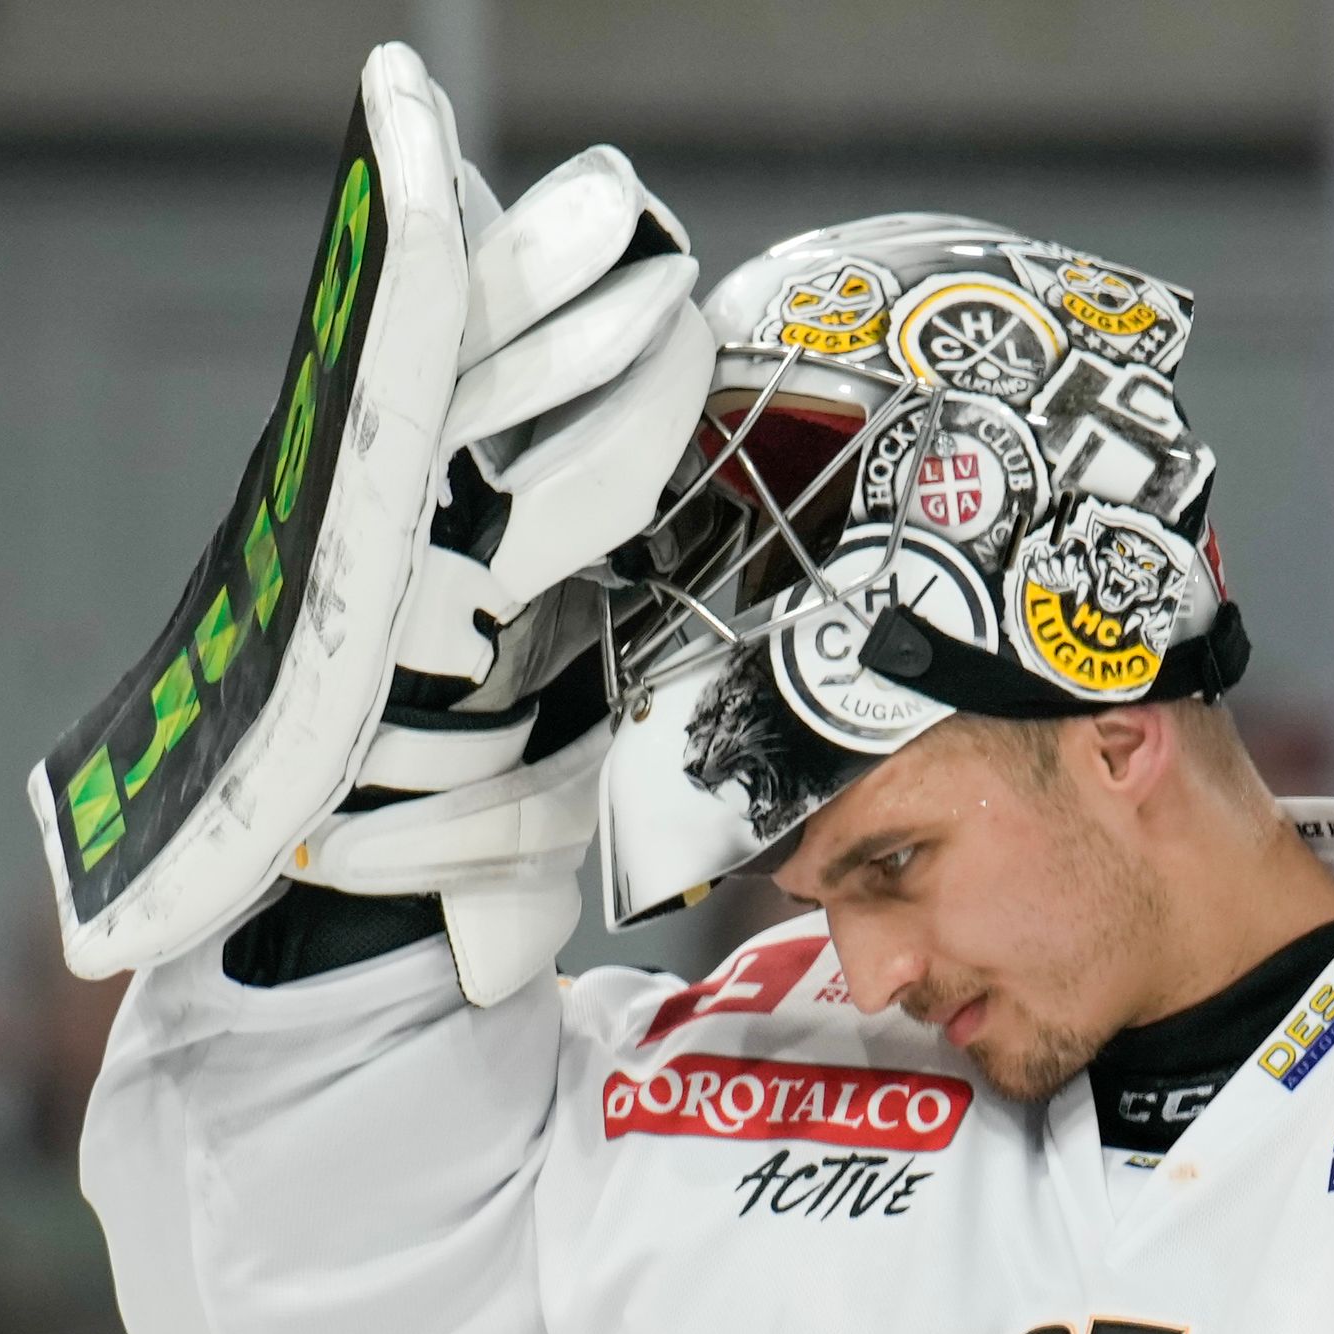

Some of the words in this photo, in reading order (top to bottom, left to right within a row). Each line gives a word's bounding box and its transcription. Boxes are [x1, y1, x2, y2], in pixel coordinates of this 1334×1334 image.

[1068, 298, 1154, 331] LUGANO
[978, 418, 1033, 491] CLUB
[1030, 597, 1150, 683] LUGANO
[1071, 602, 1122, 648] HC
[734, 1148, 935, 1222] ACTIVE
